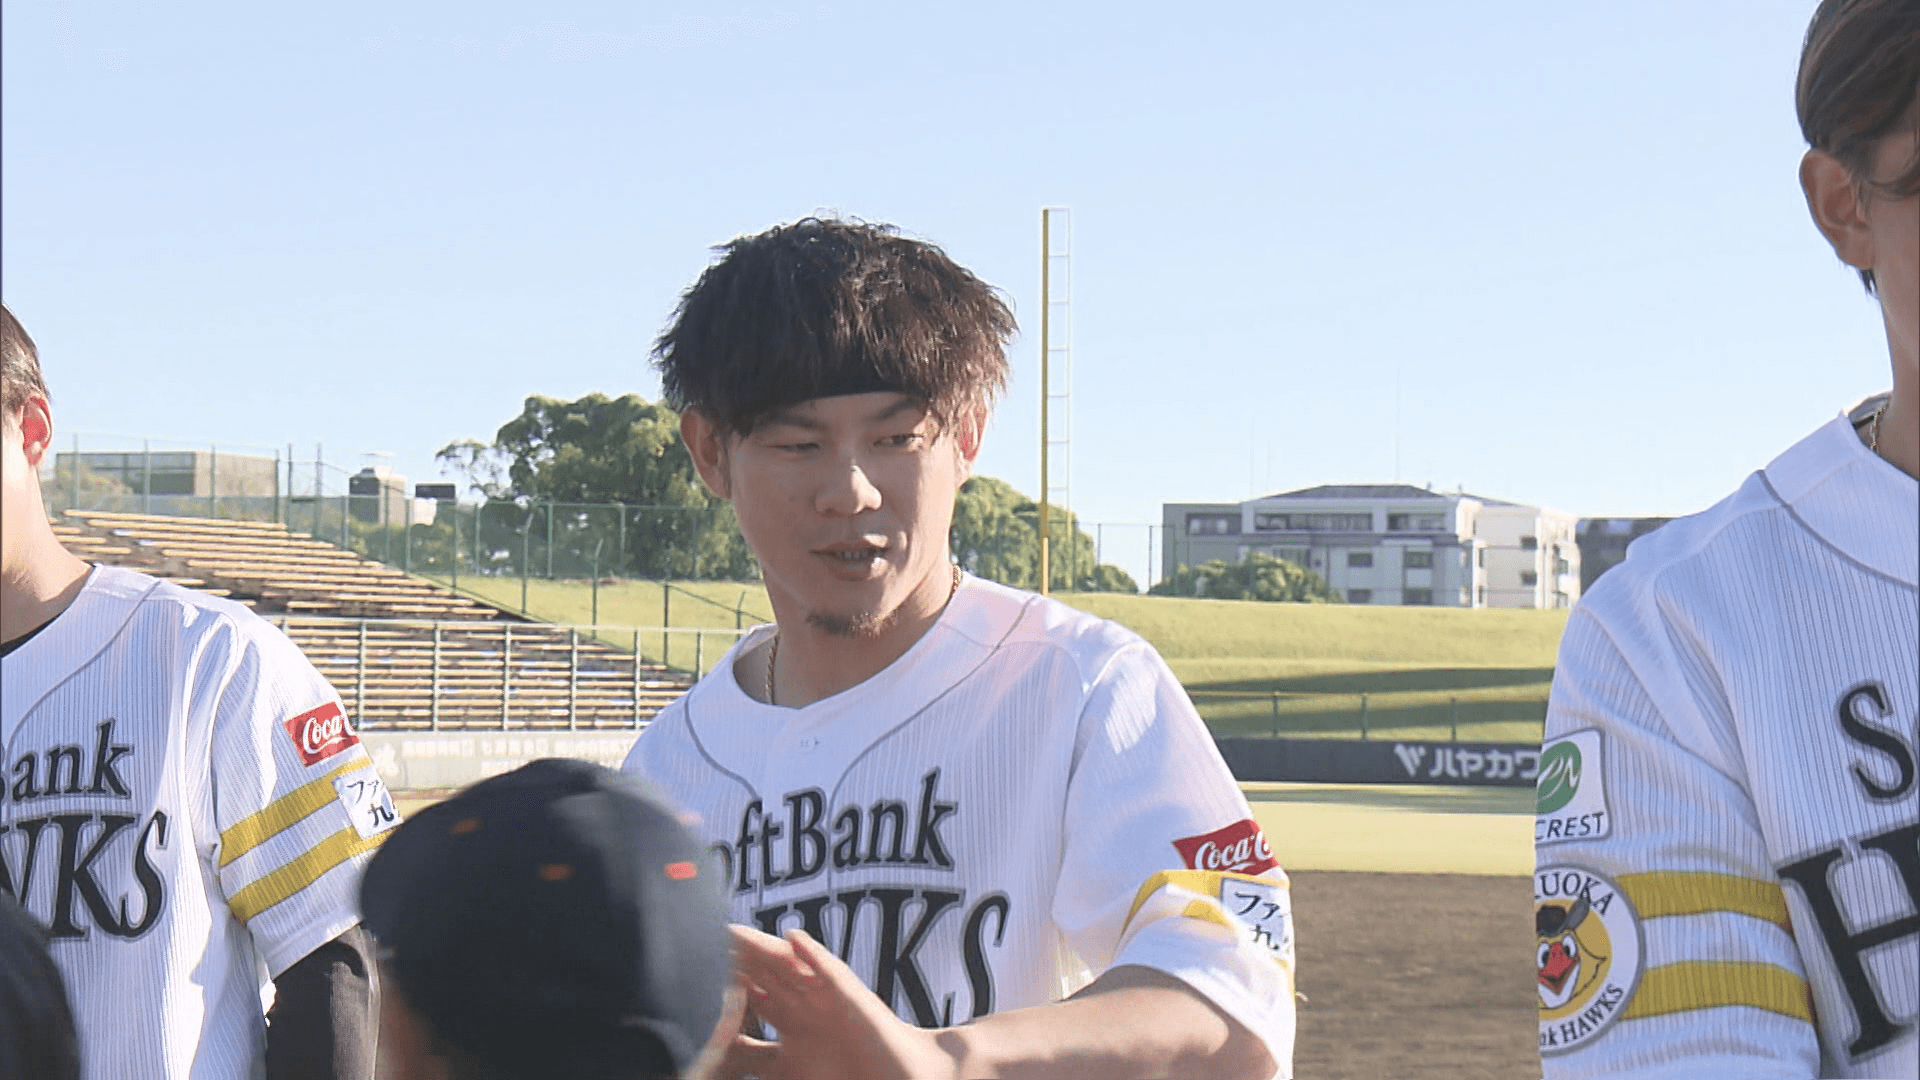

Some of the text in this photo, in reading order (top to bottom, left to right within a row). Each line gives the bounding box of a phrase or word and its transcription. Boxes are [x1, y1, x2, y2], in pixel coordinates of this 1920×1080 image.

[0, 718, 135, 803] ank
[1429, 748, 1541, 779] ハヤカワ
[1535, 872, 1615, 916] UOKA
[1559, 984, 1625, 1044] HAWKS
